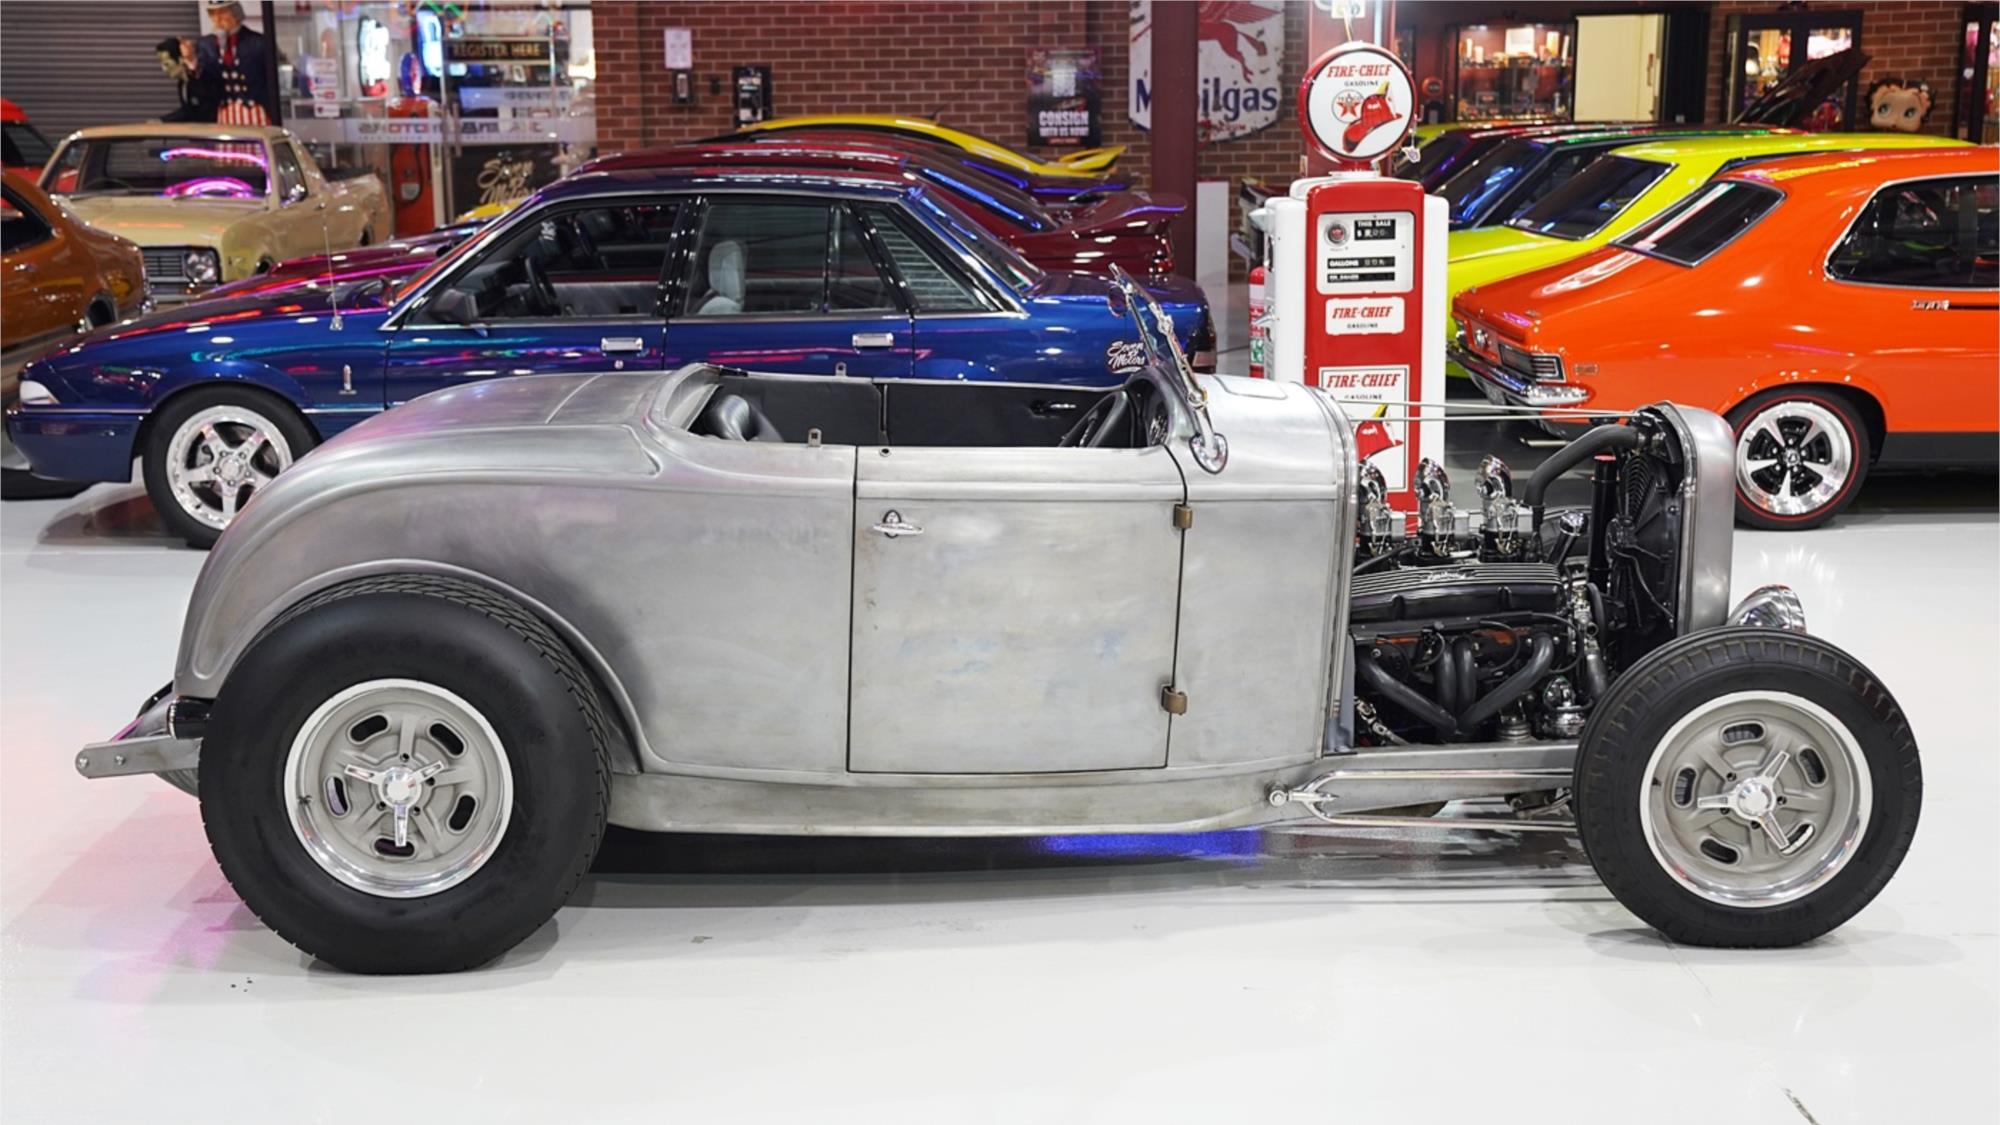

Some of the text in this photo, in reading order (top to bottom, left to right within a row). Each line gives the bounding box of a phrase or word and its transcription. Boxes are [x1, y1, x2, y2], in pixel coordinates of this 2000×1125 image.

[453, 43, 540, 57] REGISTER HERE
[1136, 77, 1278, 122] Milgas
[1039, 110, 1089, 126] CONSIGN
[1332, 306, 1393, 319] FIRE-CHIEF
[1327, 373, 1401, 388] FIRE-CHIEF
